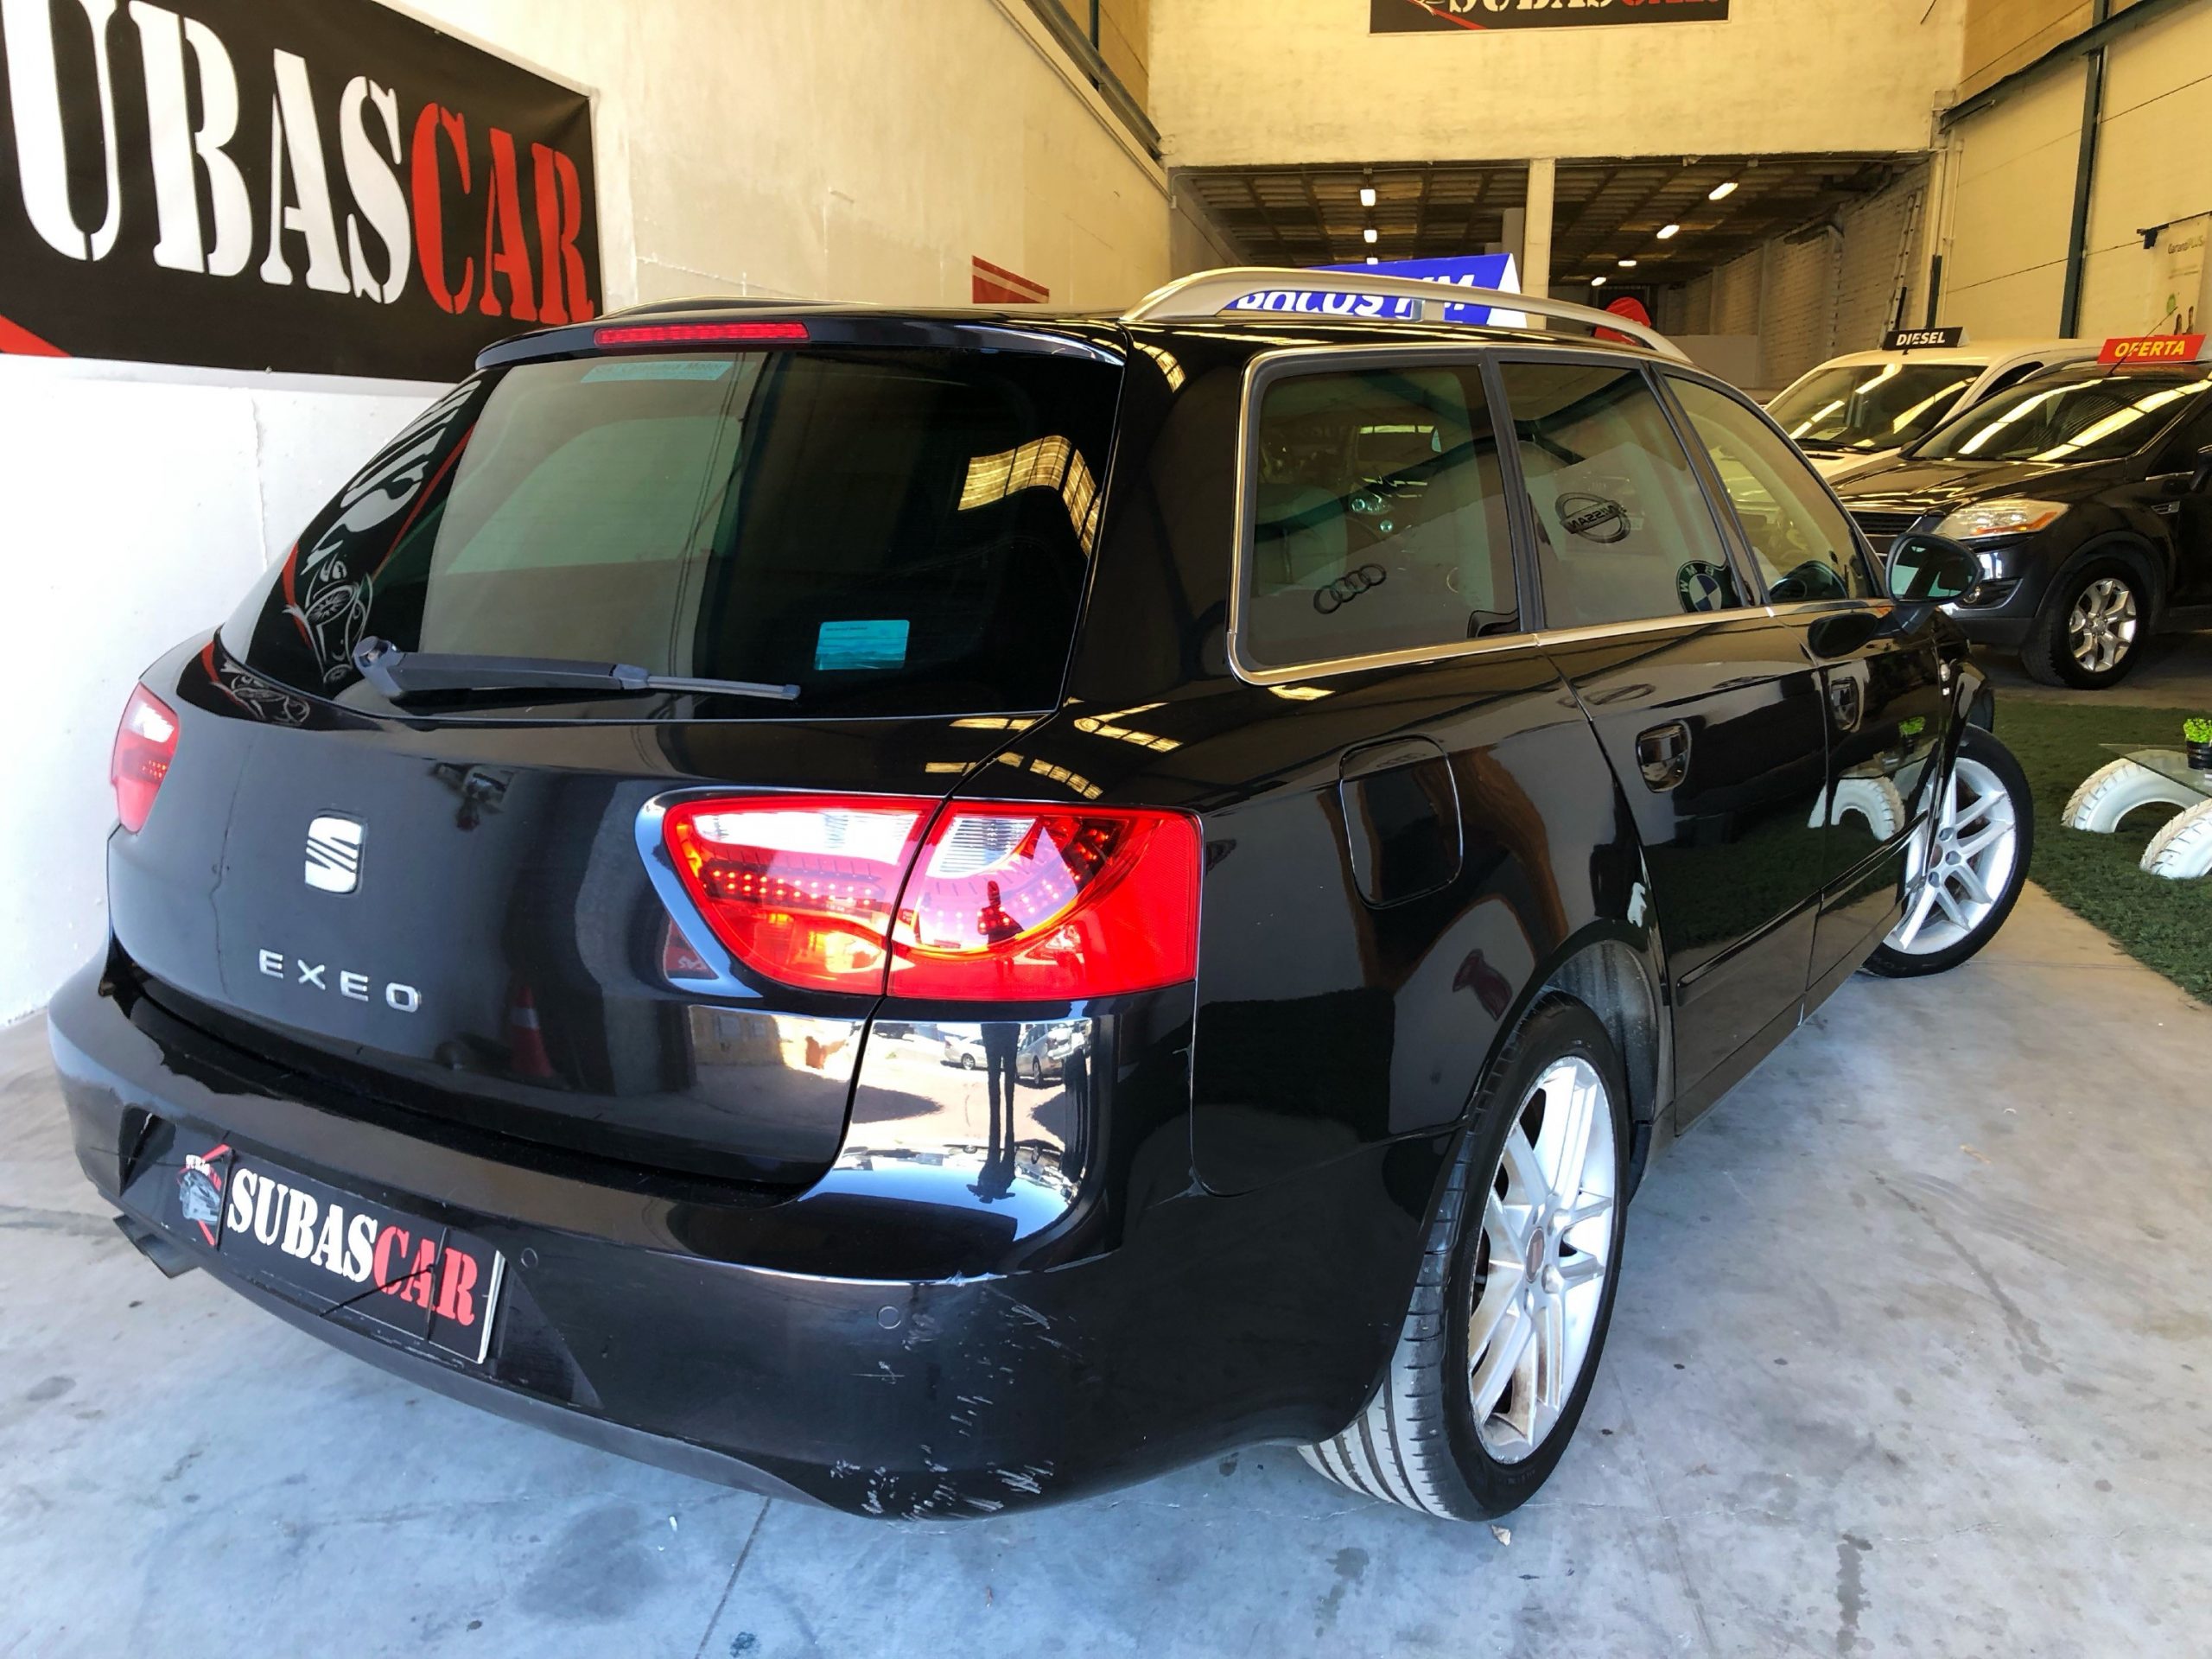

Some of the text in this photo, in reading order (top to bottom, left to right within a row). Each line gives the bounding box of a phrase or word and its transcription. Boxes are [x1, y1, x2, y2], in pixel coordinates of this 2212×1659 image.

[1896, 331, 1946, 346] DIESEL
[2114, 340, 2186, 357] OFERTA
[259, 949, 421, 1013] EXEO
[227, 1168, 478, 1325] SUBASCAR
